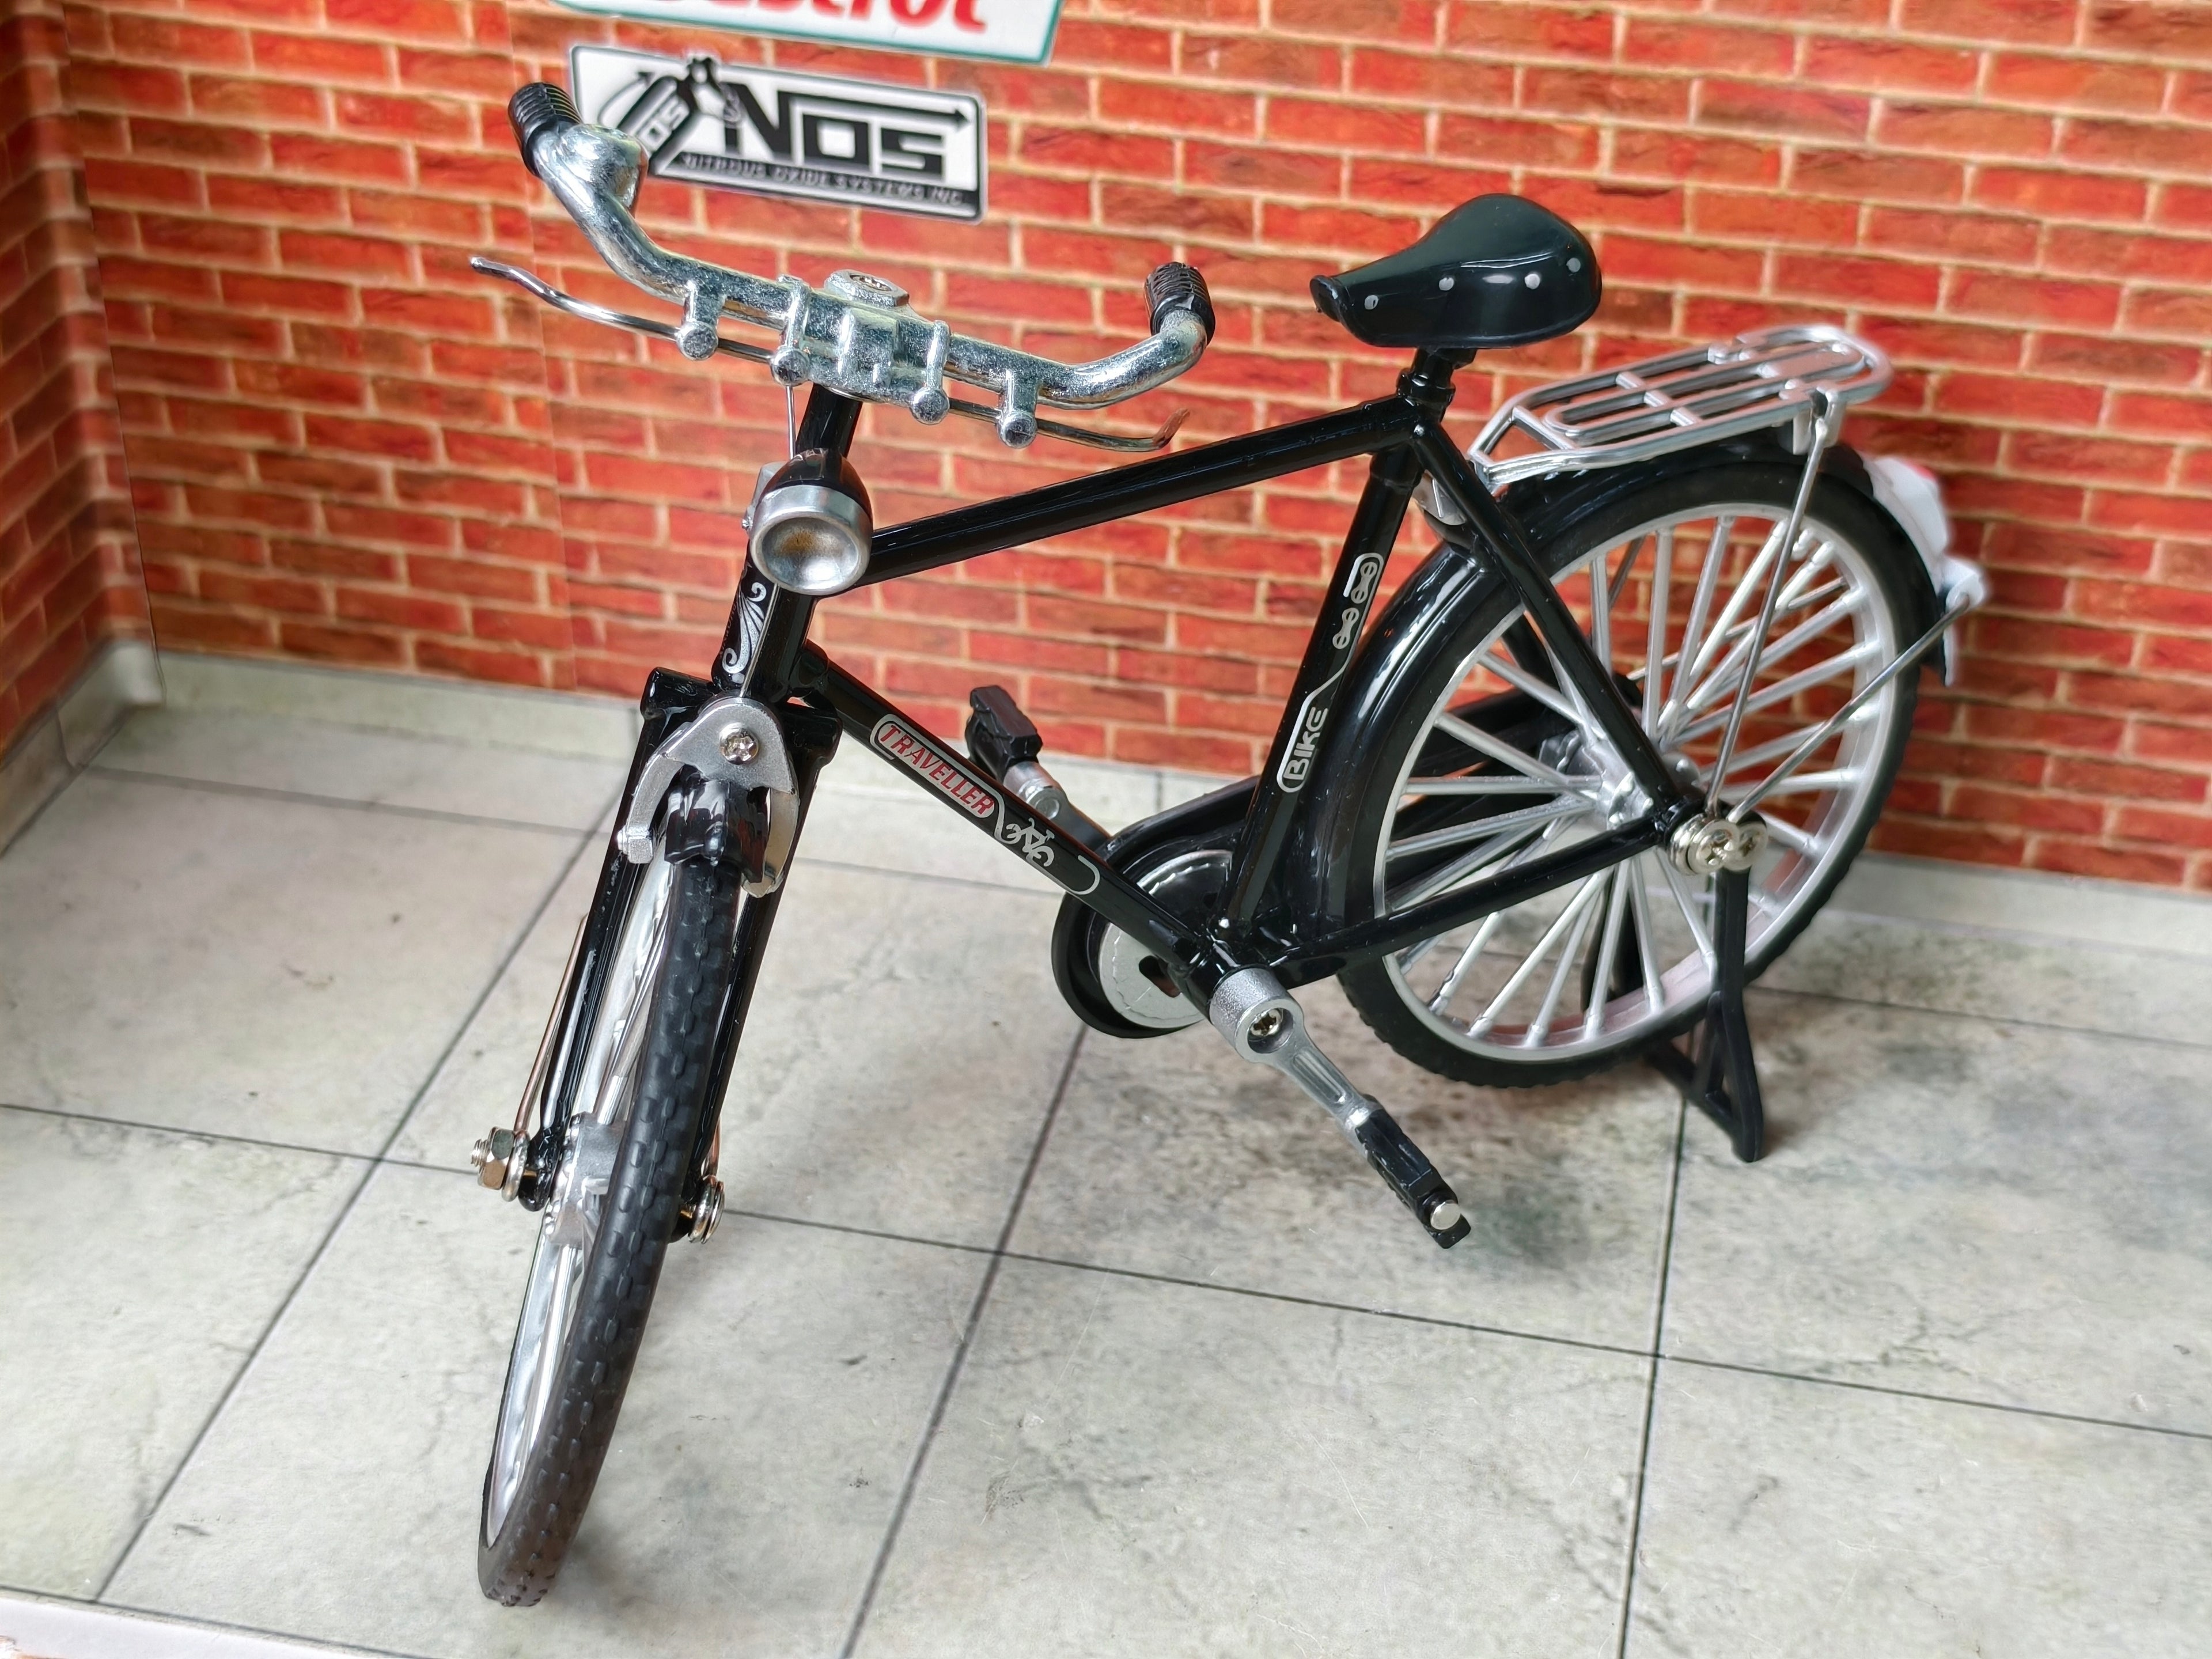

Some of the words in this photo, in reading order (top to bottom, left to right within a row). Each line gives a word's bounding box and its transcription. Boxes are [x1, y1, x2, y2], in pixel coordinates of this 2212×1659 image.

[722, 82, 945, 182] NOS
[880, 724, 995, 815] TRAVELLER
[1282, 706, 1328, 781] BIKE
